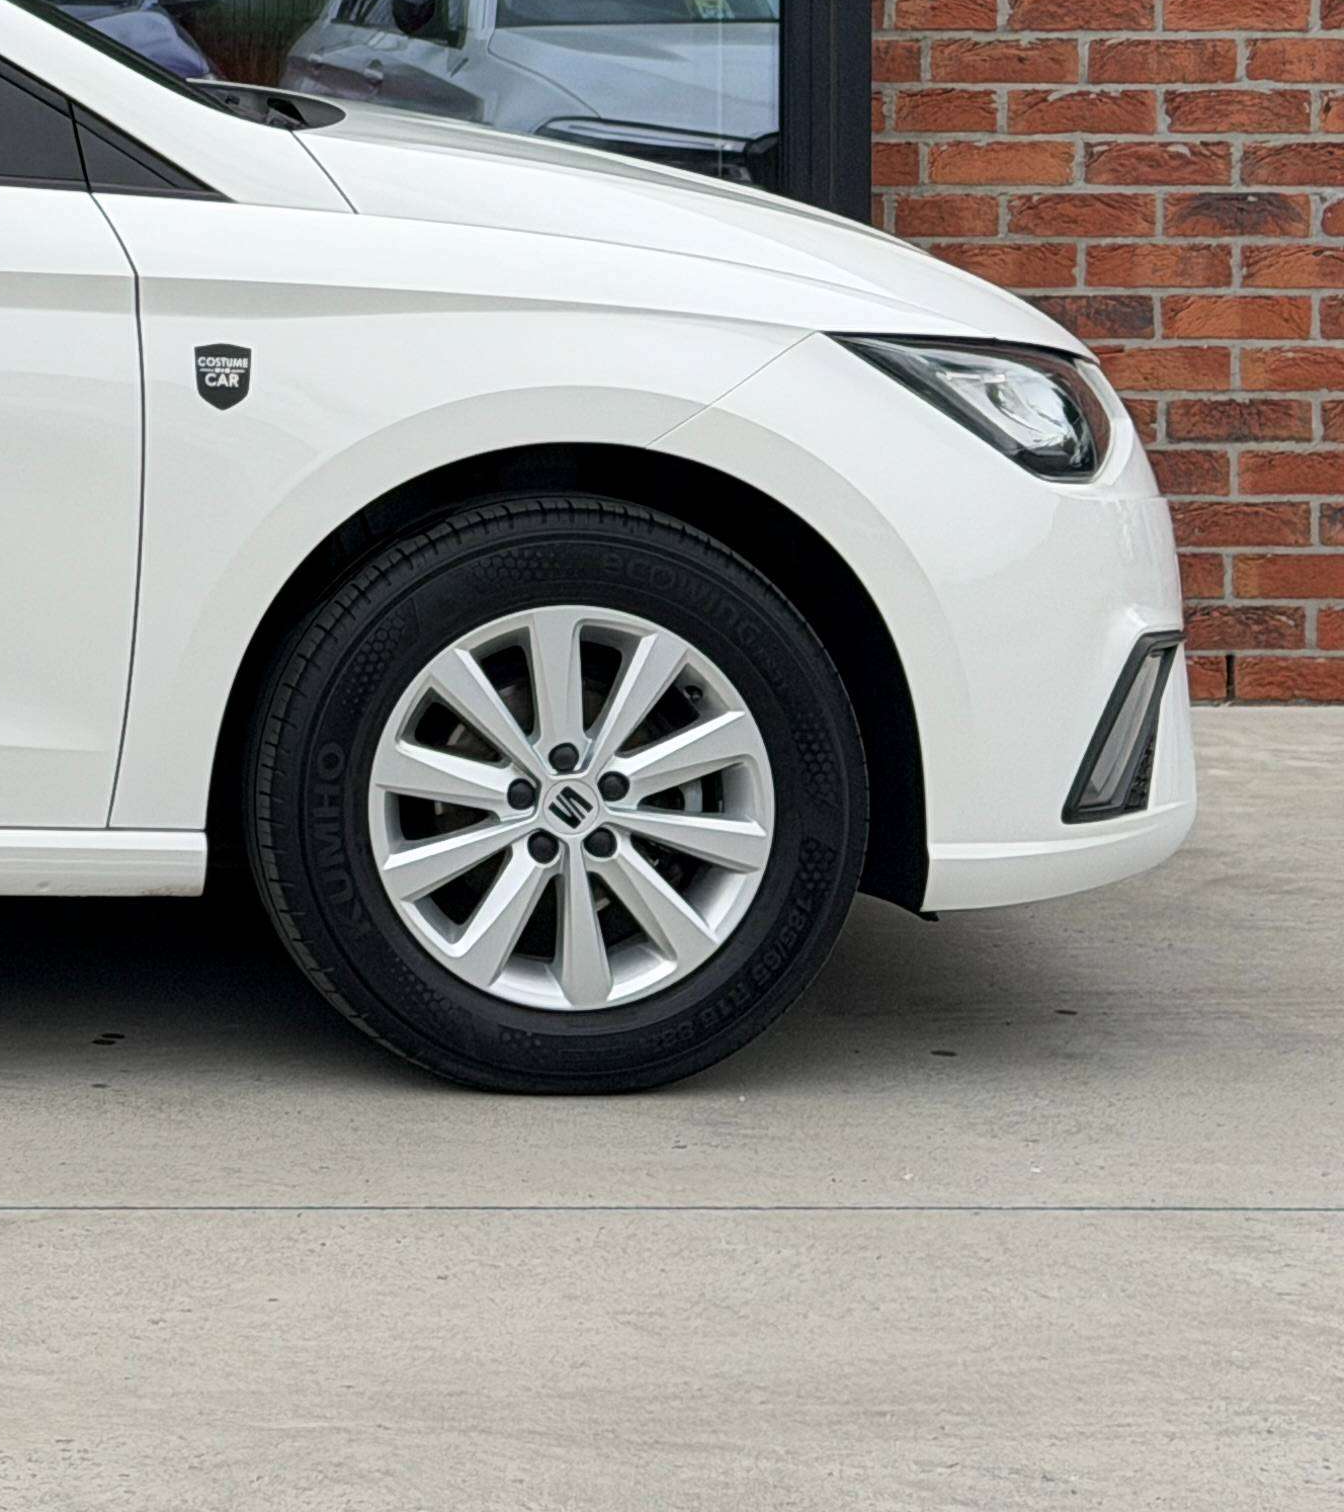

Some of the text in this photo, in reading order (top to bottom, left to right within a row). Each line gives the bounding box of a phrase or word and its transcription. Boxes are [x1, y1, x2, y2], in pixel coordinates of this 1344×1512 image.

[197, 355, 249, 369] COSTUME
[204, 373, 240, 388] CAR
[310, 740, 373, 939] KUMHO
